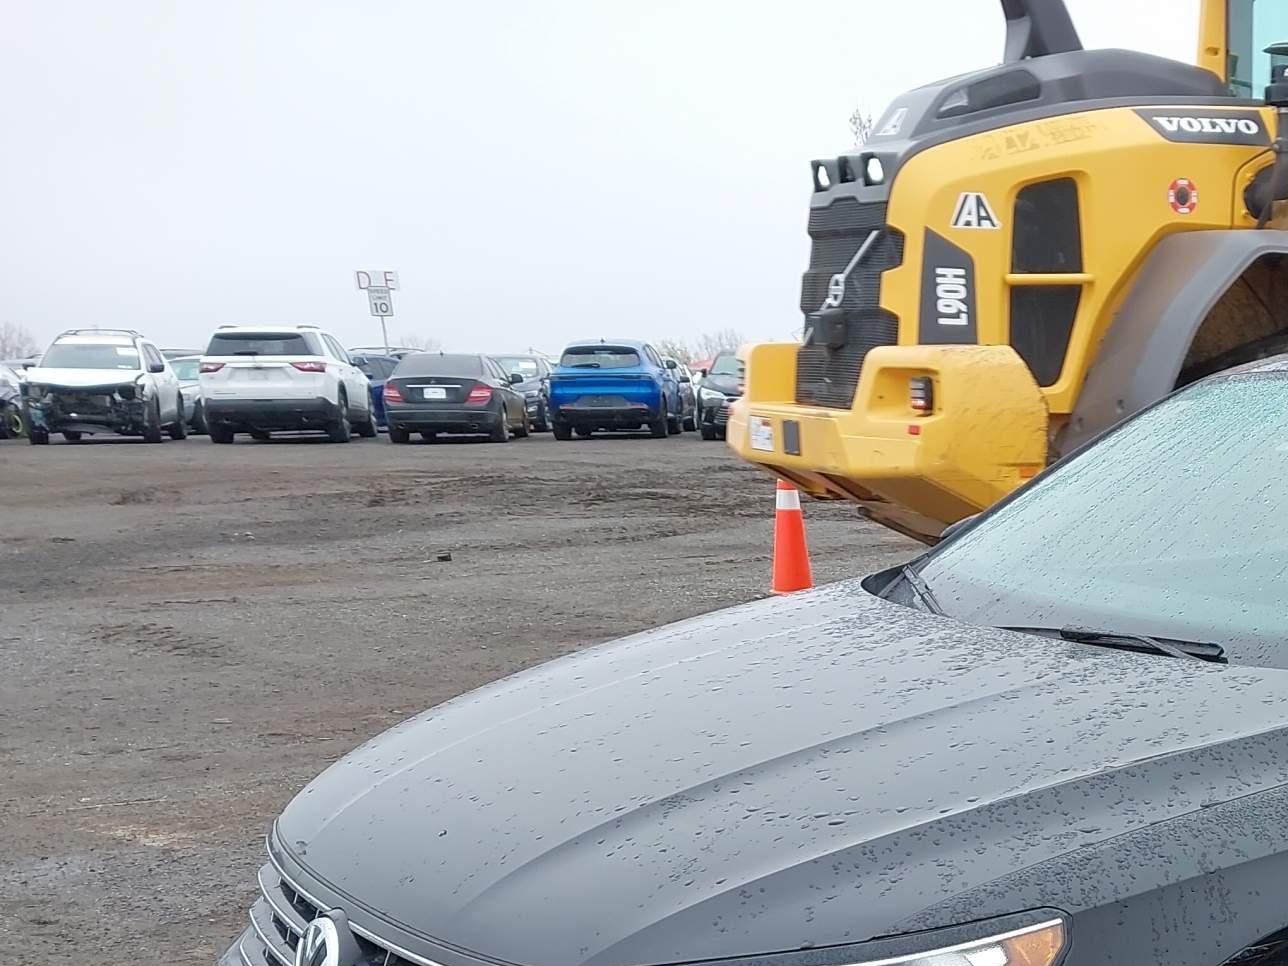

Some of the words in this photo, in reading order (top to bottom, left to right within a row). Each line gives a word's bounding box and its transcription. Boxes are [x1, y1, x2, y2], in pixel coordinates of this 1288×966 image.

[1152, 116, 1259, 135] VOLVO
[356, 270, 372, 290] D
[935, 266, 969, 326] L90H
[373, 302, 389, 313] 10
